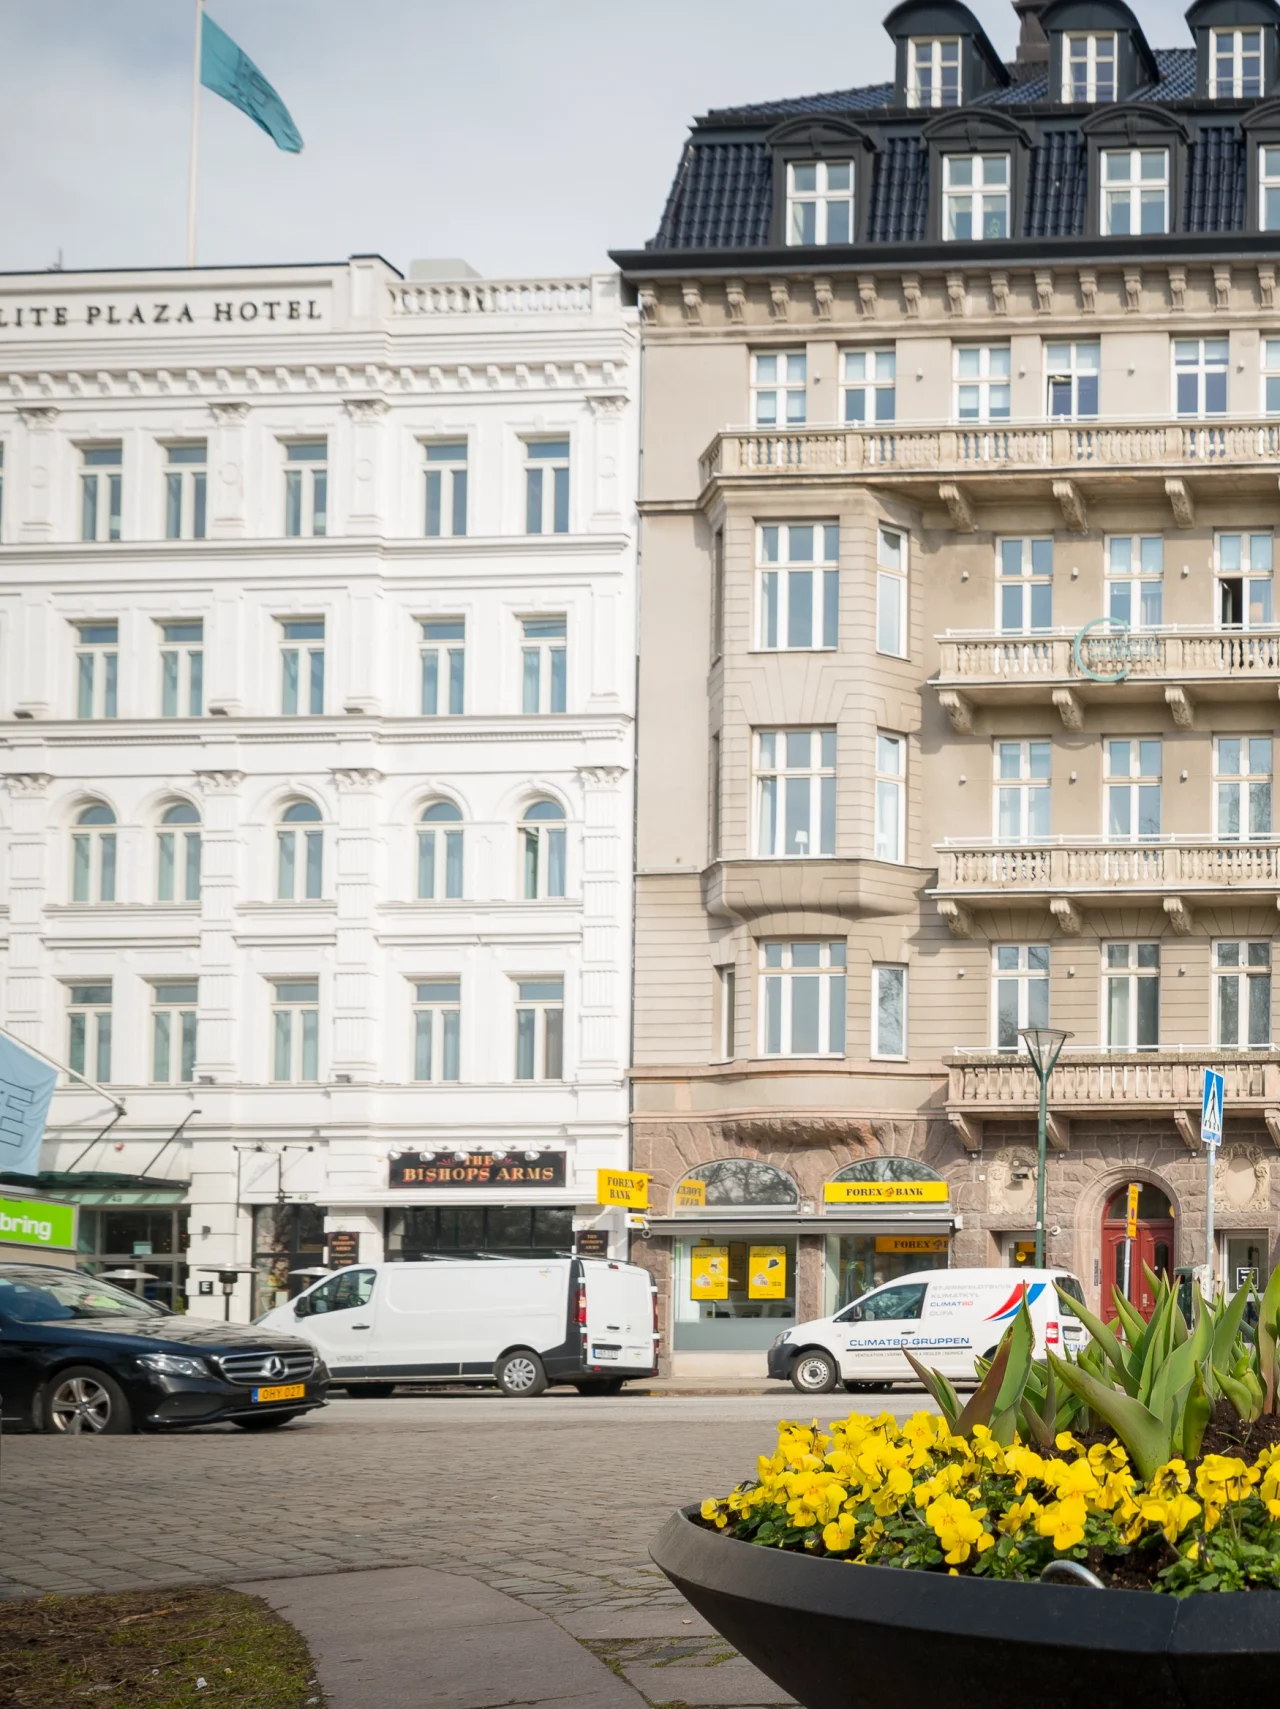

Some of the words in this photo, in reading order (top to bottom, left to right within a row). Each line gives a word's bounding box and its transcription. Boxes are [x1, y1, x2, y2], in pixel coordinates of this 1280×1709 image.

[86, 303, 194, 326] PLAZA
[213, 300, 323, 322] HOTEL
[464, 1155, 494, 1166] THE
[402, 1168, 490, 1182] BISHOPS
[496, 1167, 554, 1181] ARMS
[607, 1176, 635, 1189] FOREX
[610, 1189, 631, 1200] BANK
[846, 1188, 882, 1196] FOREX
[896, 1188, 923, 1196] BANK
[0, 1212, 52, 1240] bring
[894, 1241, 930, 1249] FOREX
[201, 1281, 211, 1292] E
[262, 1389, 281, 1399] OHY
